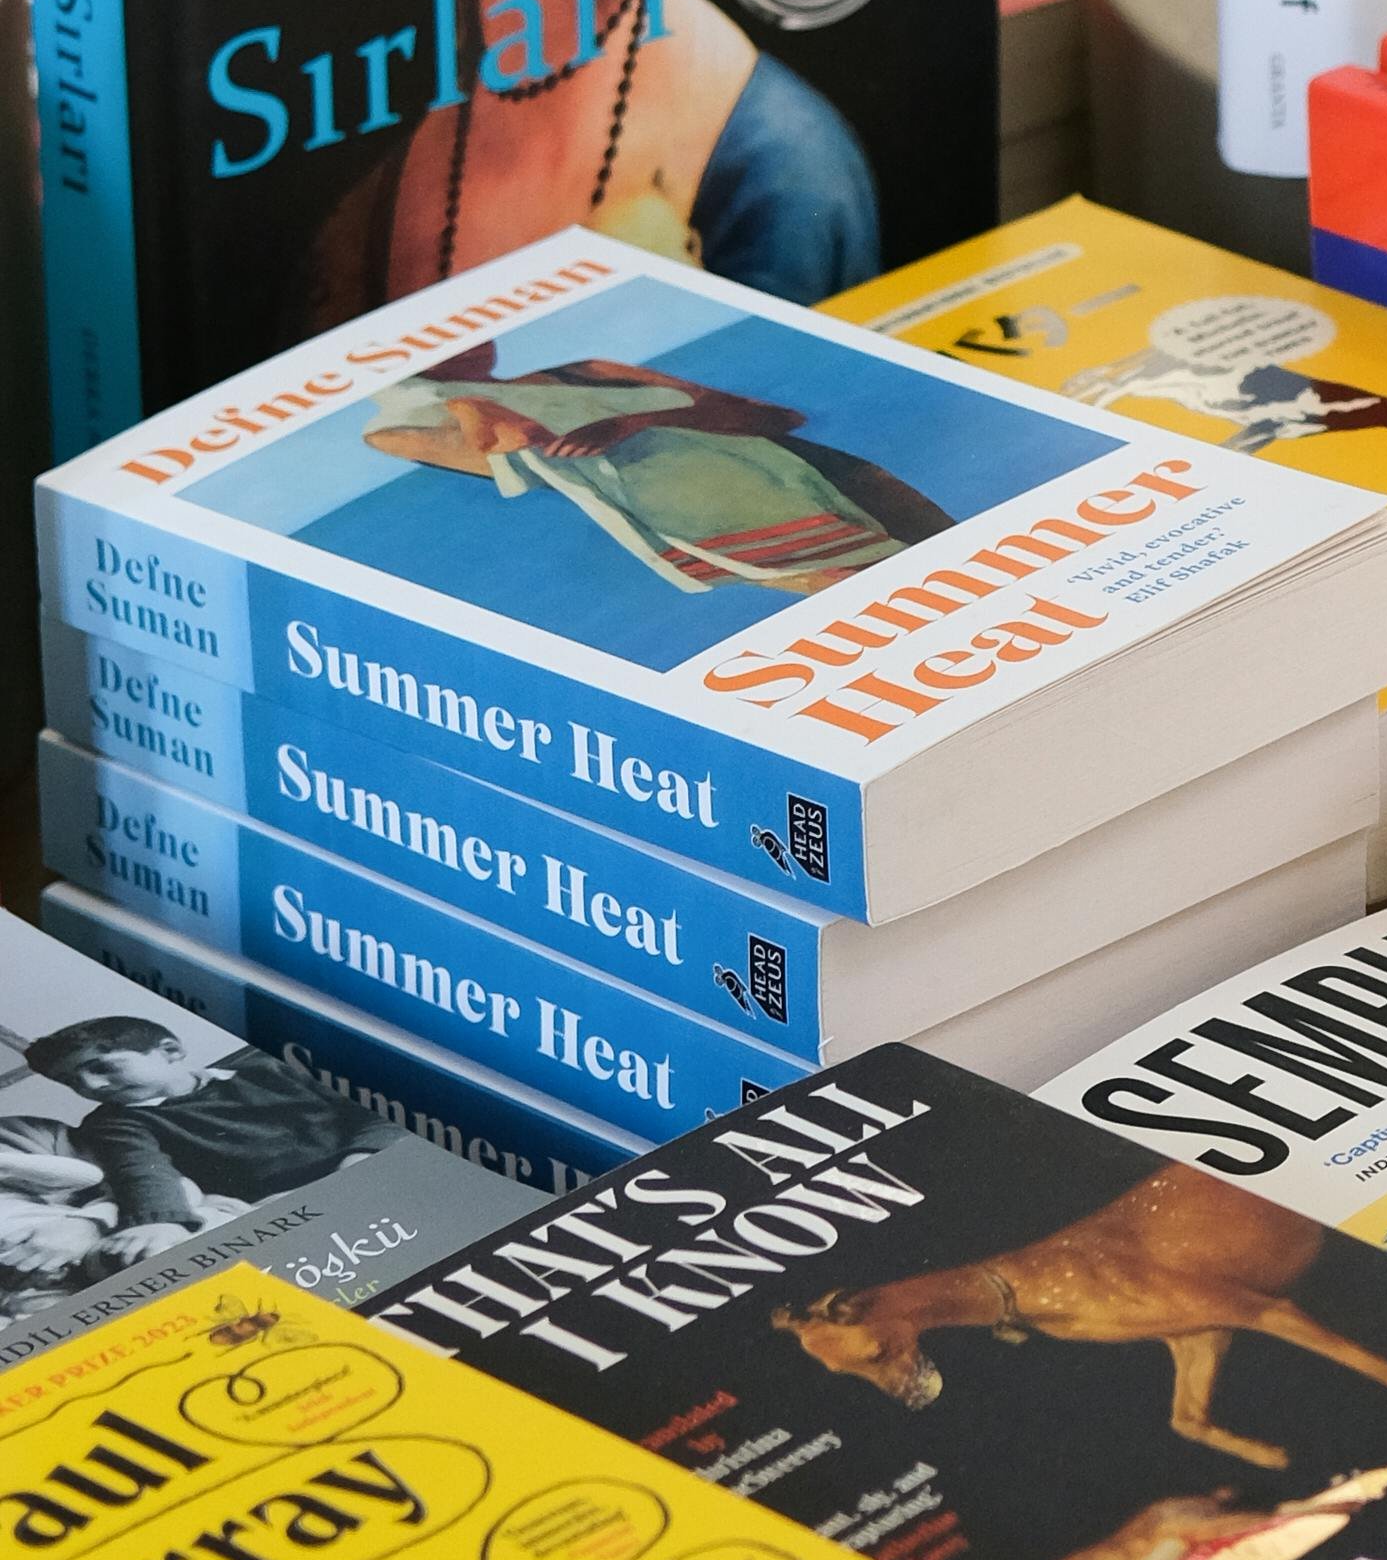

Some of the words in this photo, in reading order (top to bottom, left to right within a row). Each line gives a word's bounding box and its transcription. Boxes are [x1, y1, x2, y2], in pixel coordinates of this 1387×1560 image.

[120, 369, 355, 485] Defne
[346, 257, 619, 377] Suman
[1147, 495, 1247, 553] evocative
[95, 538, 207, 608] Defne
[702, 459, 1208, 710] Summer
[1100, 567, 1145, 595] and
[1124, 576, 1172, 605] Elif
[1170, 536, 1250, 583] Shafak
[86, 577, 221, 659] Suman
[98, 655, 202, 728] Defne
[788, 592, 1109, 746] Heat
[89, 695, 215, 779] Suman
[286, 620, 553, 763] Summer
[568, 720, 719, 830] Heat
[98, 794, 199, 867] Defne
[276, 741, 526, 895] Summer
[541, 854, 685, 967] Heat
[792, 802, 809, 861] HEAD
[807, 808, 825, 866] ZEUS
[86, 840, 210, 917] Suman
[272, 883, 521, 1039] Summer
[536, 995, 676, 1110] Heat
[752, 941, 769, 1001] HEAD
[768, 947, 784, 1005] ZEUS
[713, 1082, 931, 1187] ALL
[72, 1267, 192, 1325] ERNER
[520, 1316, 628, 1373] I
[591, 1152, 926, 1333] KNOW
[133, 1313, 198, 1351] 2023
